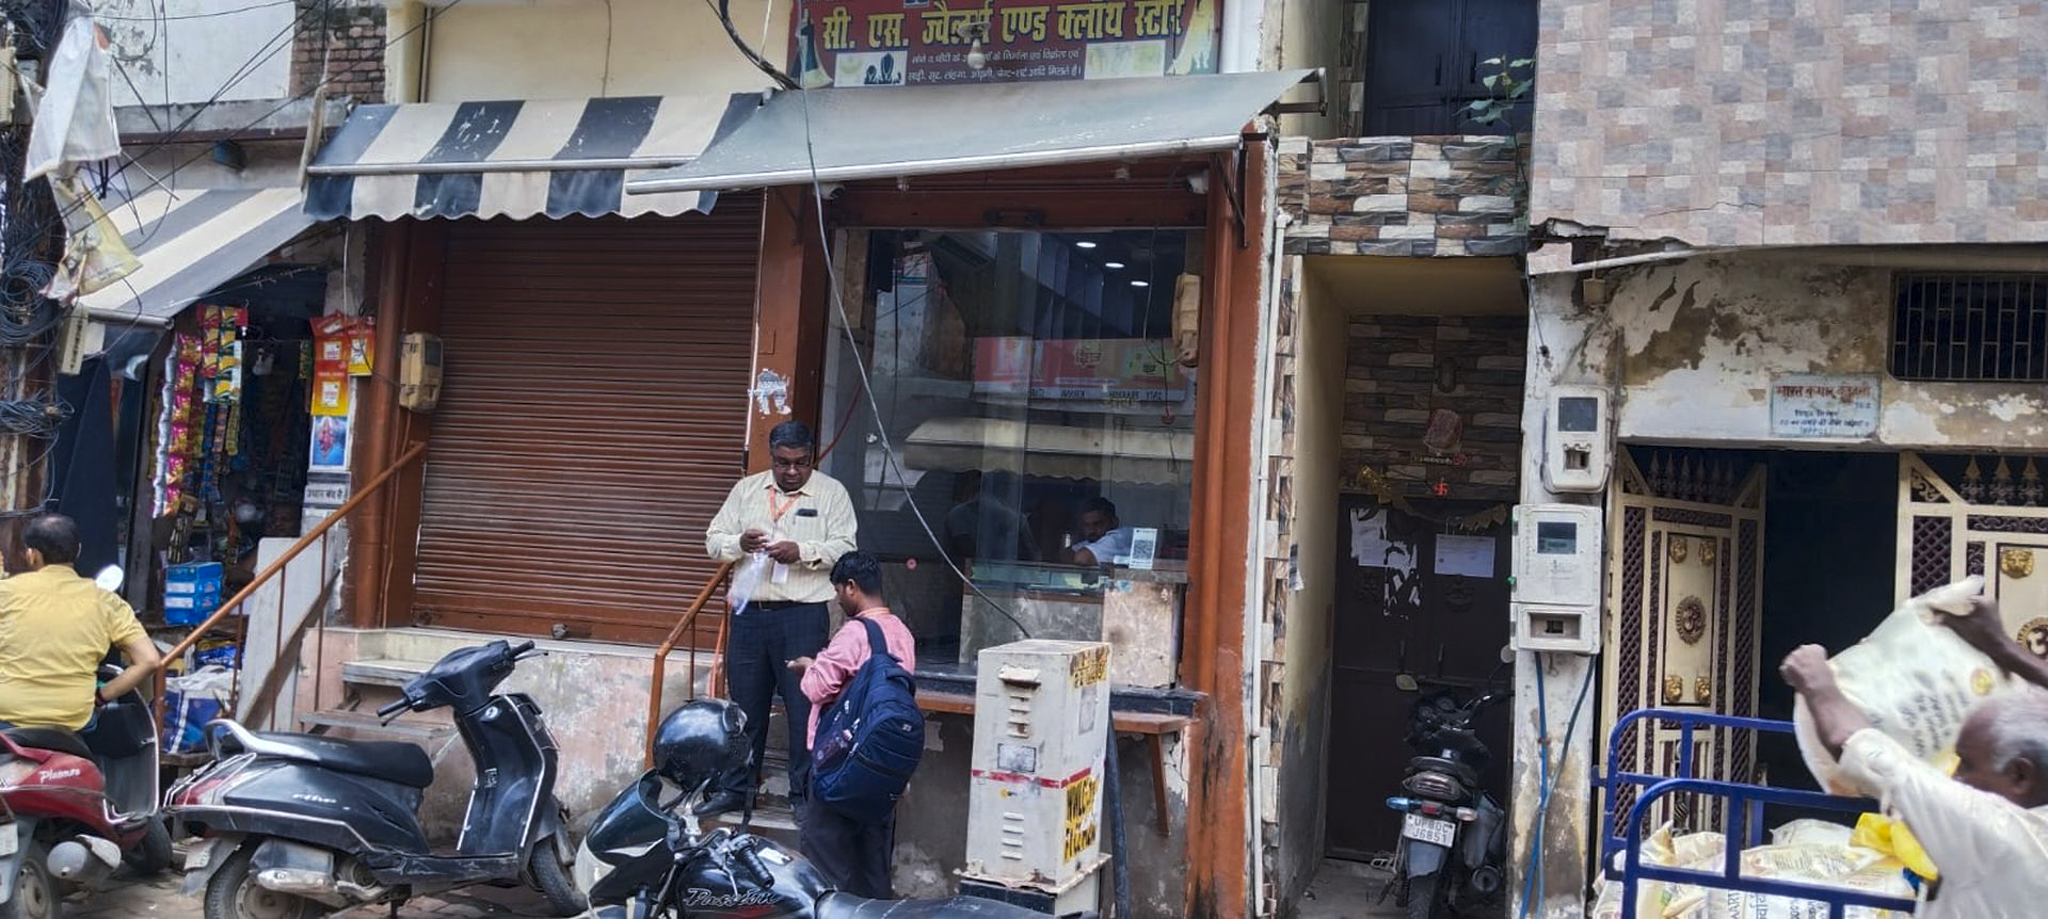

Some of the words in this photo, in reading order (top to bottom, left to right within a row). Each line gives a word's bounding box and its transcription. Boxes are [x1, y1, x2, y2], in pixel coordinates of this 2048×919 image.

[822, 6, 856, 50] सी.
[867, 13, 909, 48] एस.
[1000, 5, 1051, 43] एण्ड
